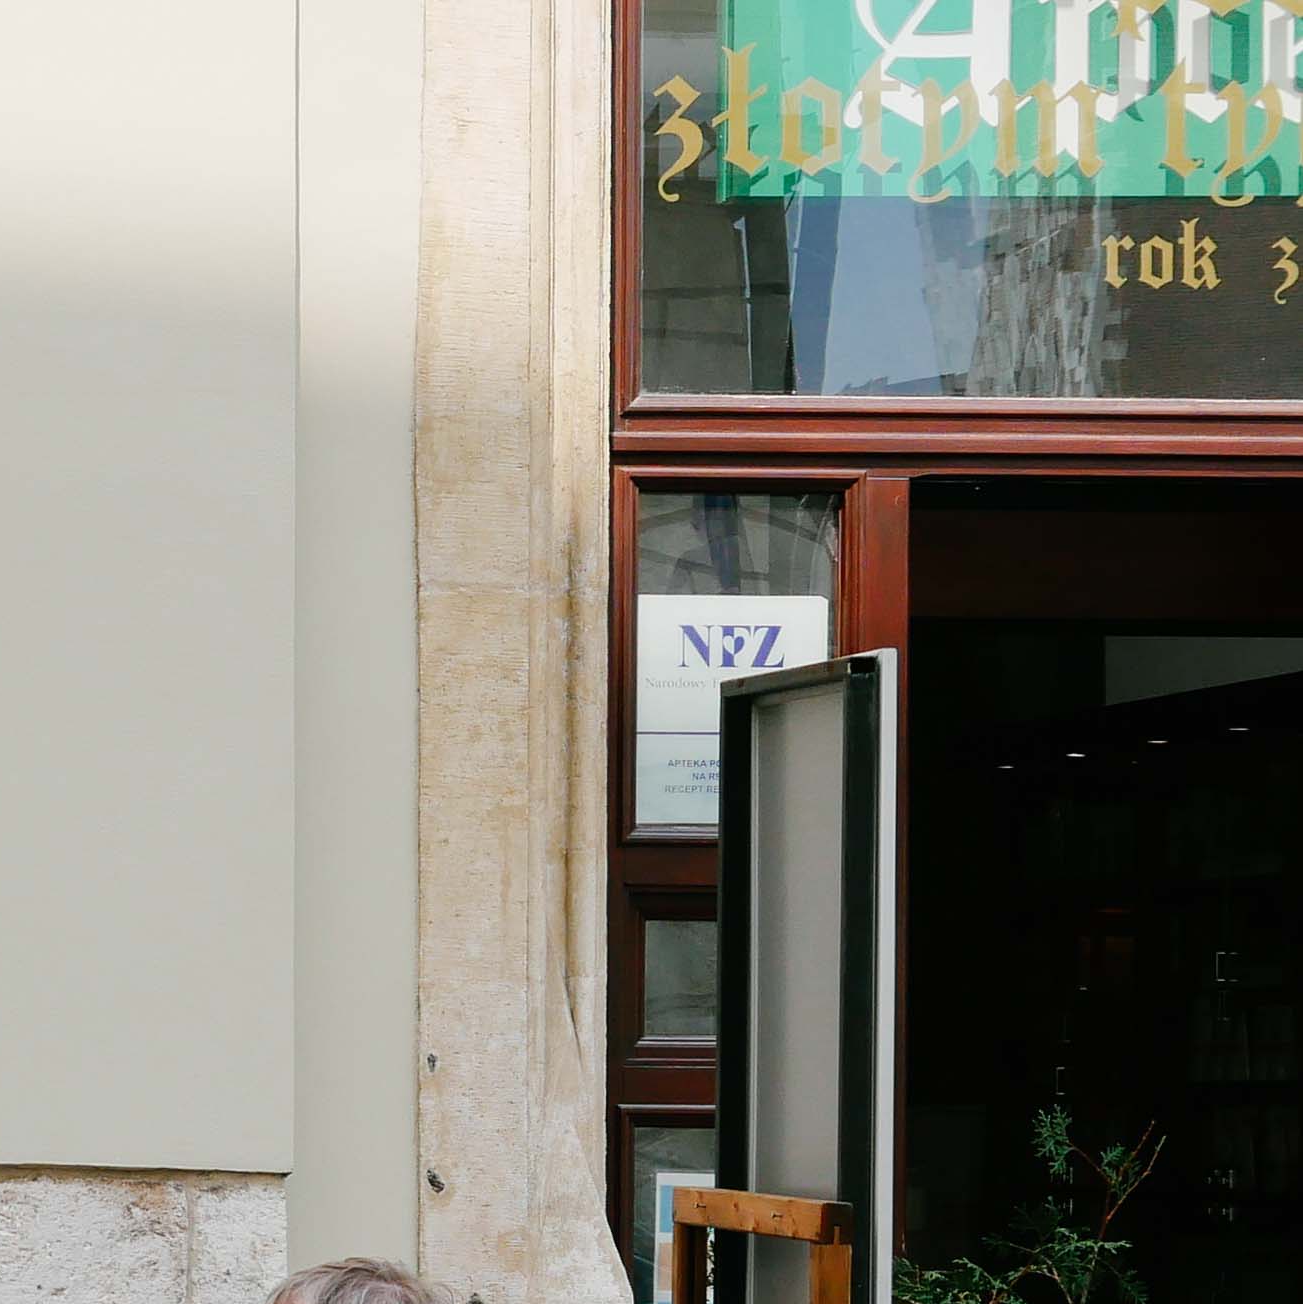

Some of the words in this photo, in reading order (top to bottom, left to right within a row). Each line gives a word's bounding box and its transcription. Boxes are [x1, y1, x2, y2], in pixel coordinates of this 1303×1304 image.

[1158, 56, 1303, 208] ty
[1102, 217, 1222, 290] rok
[678, 624, 785, 668] NFZ
[645, 677, 707, 691] Narodowy
[667, 759, 707, 768] APTEKA
[692, 772, 706, 781] NA
[664, 785, 703, 793] RECEPT
